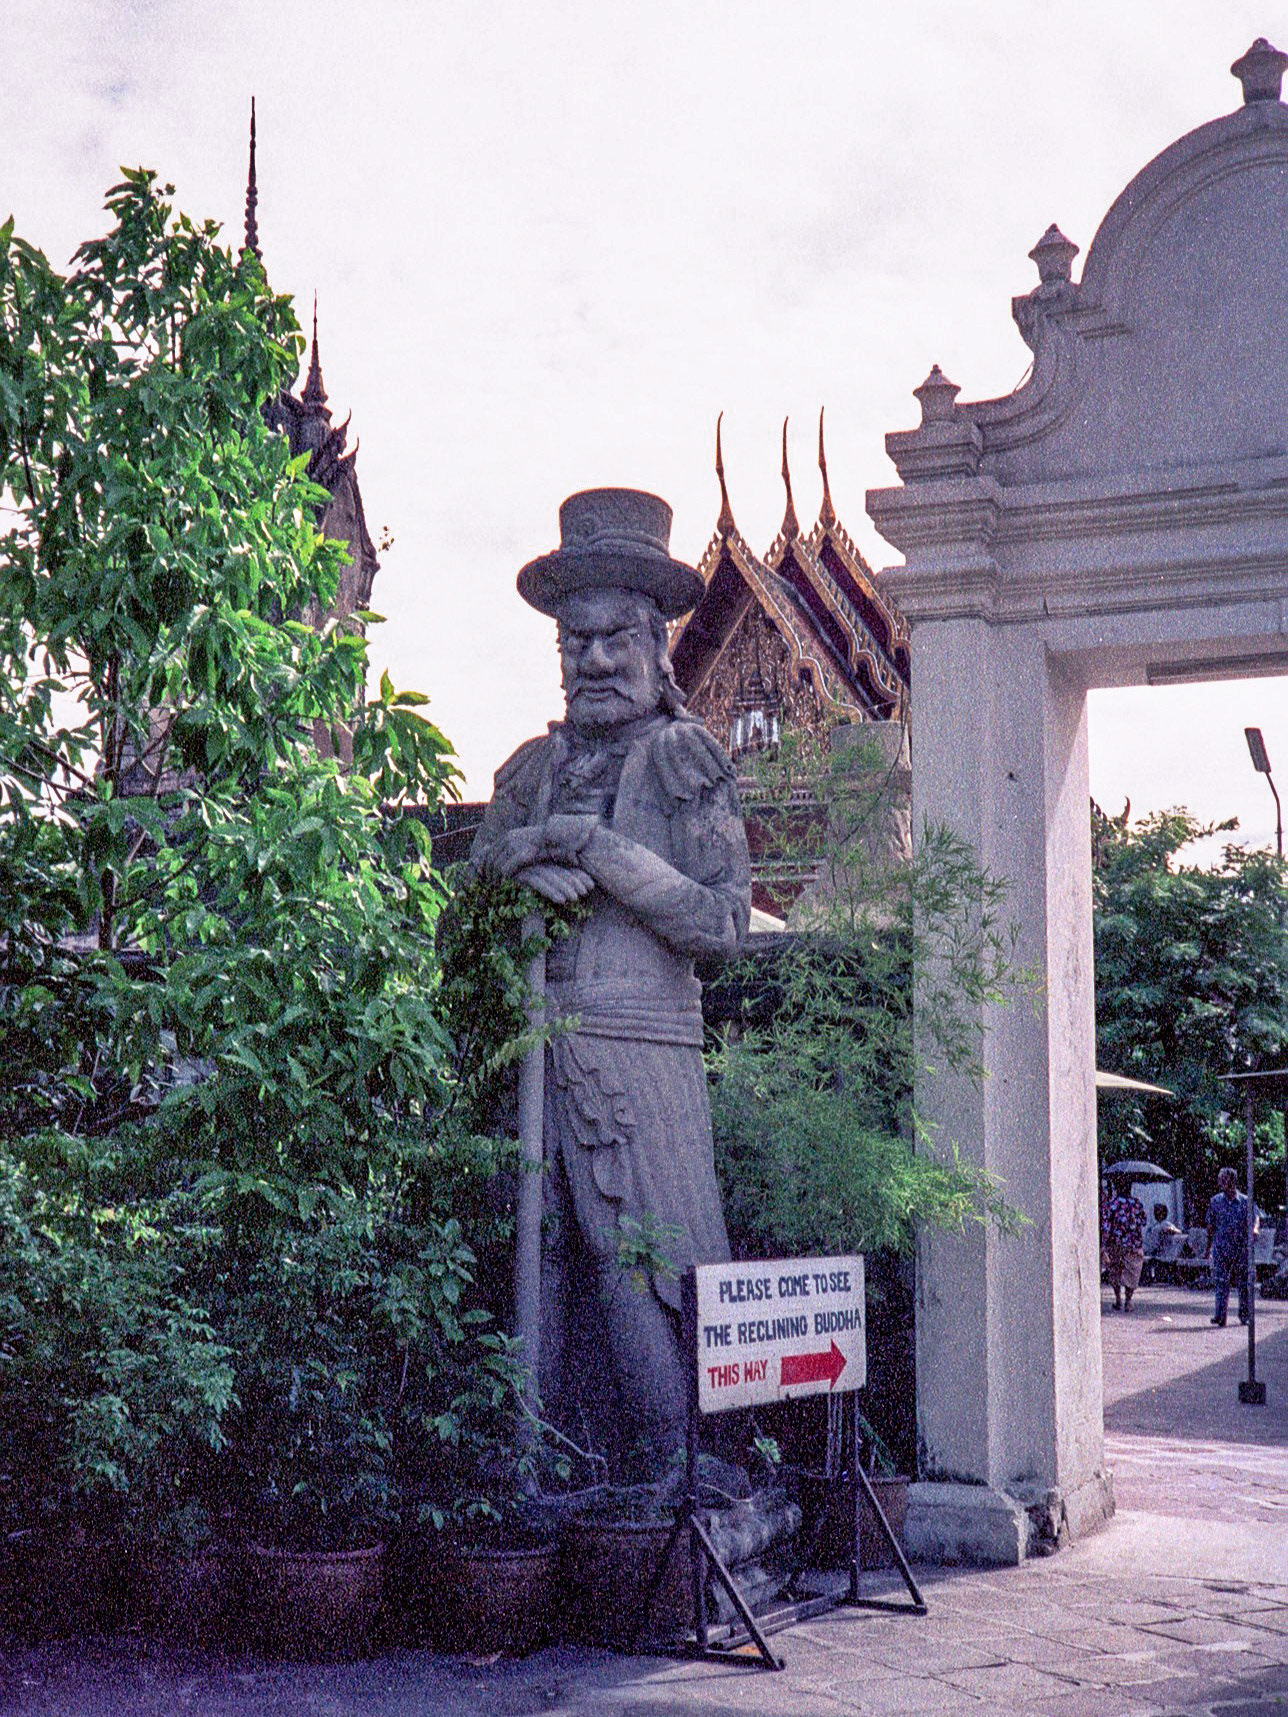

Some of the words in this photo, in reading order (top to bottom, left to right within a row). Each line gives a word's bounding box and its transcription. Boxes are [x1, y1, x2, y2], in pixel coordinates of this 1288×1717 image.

[719, 1278, 772, 1303] PLEASE
[778, 1274, 810, 1298] COME
[812, 1273, 828, 1295] TO
[829, 1271, 851, 1293] SEE
[703, 1324, 732, 1348] THE
[738, 1315, 808, 1345] RECLINING
[814, 1308, 862, 1335] BUDDHA
[707, 1363, 740, 1389] THIS
[744, 1359, 768, 1383] WAY
